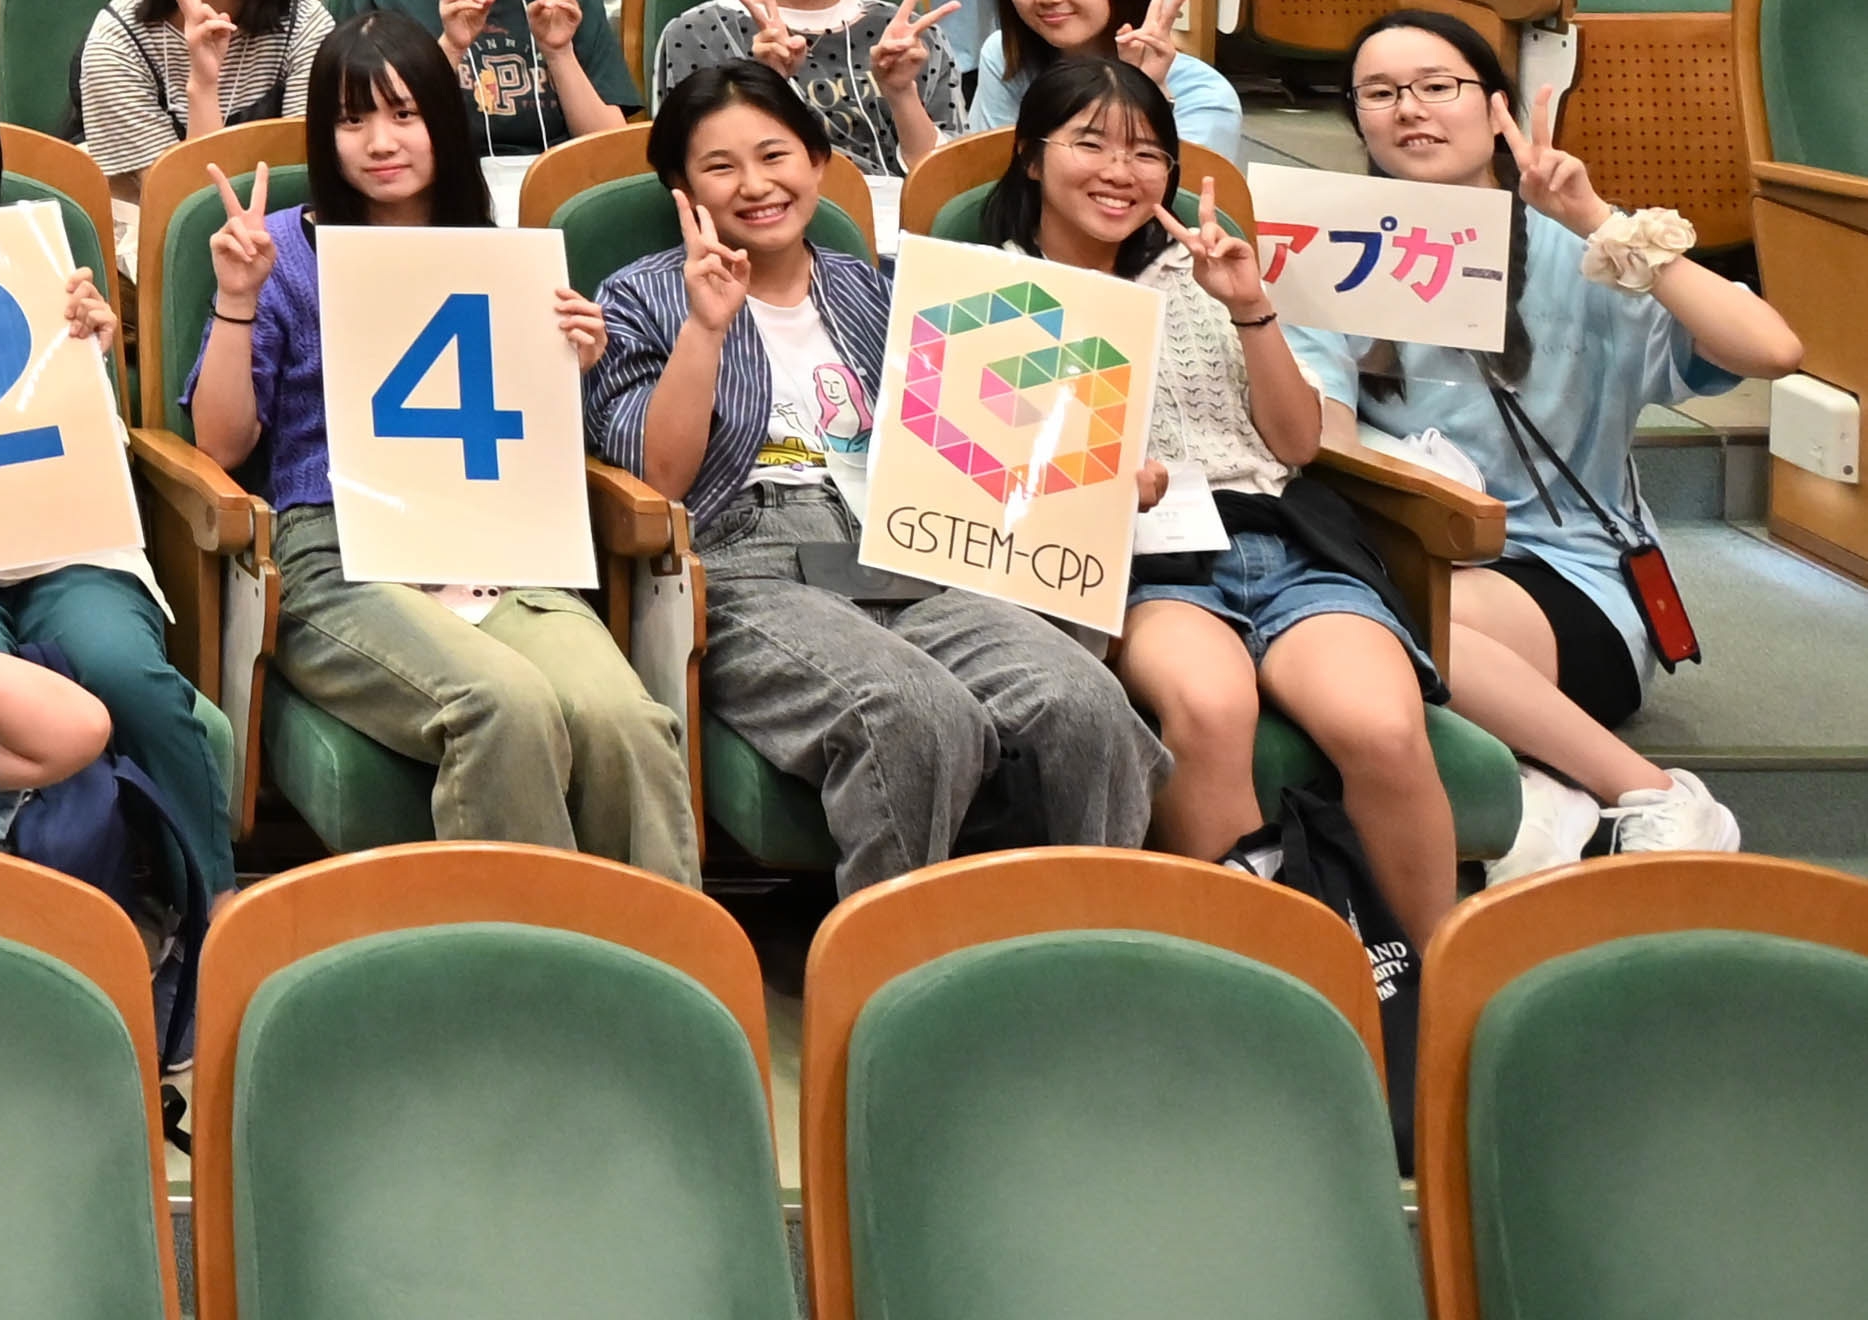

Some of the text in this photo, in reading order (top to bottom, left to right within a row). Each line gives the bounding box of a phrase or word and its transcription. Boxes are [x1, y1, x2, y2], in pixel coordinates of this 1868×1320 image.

[1256, 215, 1504, 303] アプガー
[372, 293, 524, 481] 4
[886, 505, 1105, 598] GSTEM-CPP
